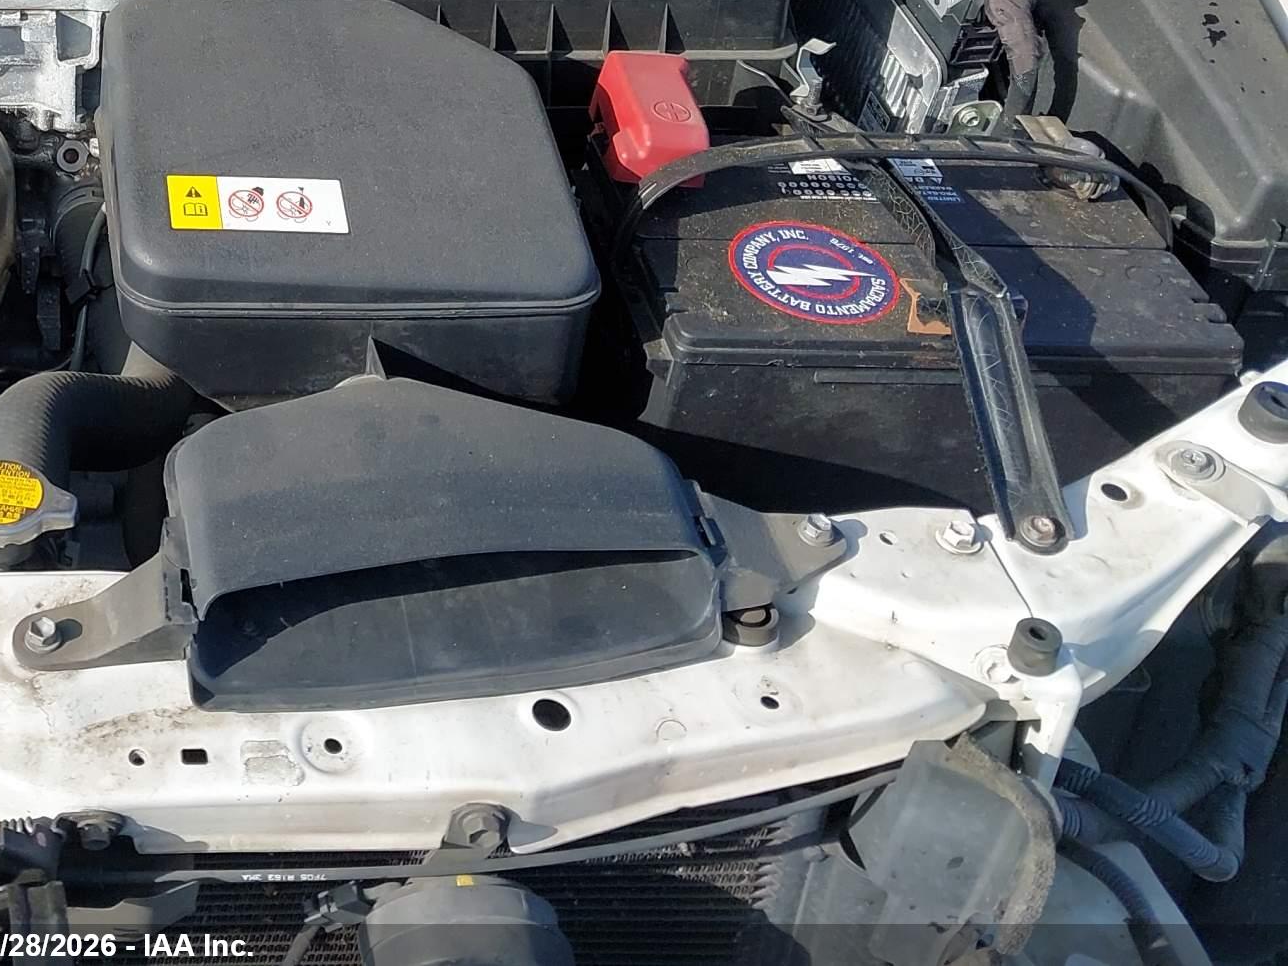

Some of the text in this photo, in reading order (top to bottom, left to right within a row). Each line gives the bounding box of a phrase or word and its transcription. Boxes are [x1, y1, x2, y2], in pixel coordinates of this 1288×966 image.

[778, 228, 810, 241] INC.
[748, 271, 812, 311] BATTERY
[815, 277, 887, 317] SACRAMENTO
